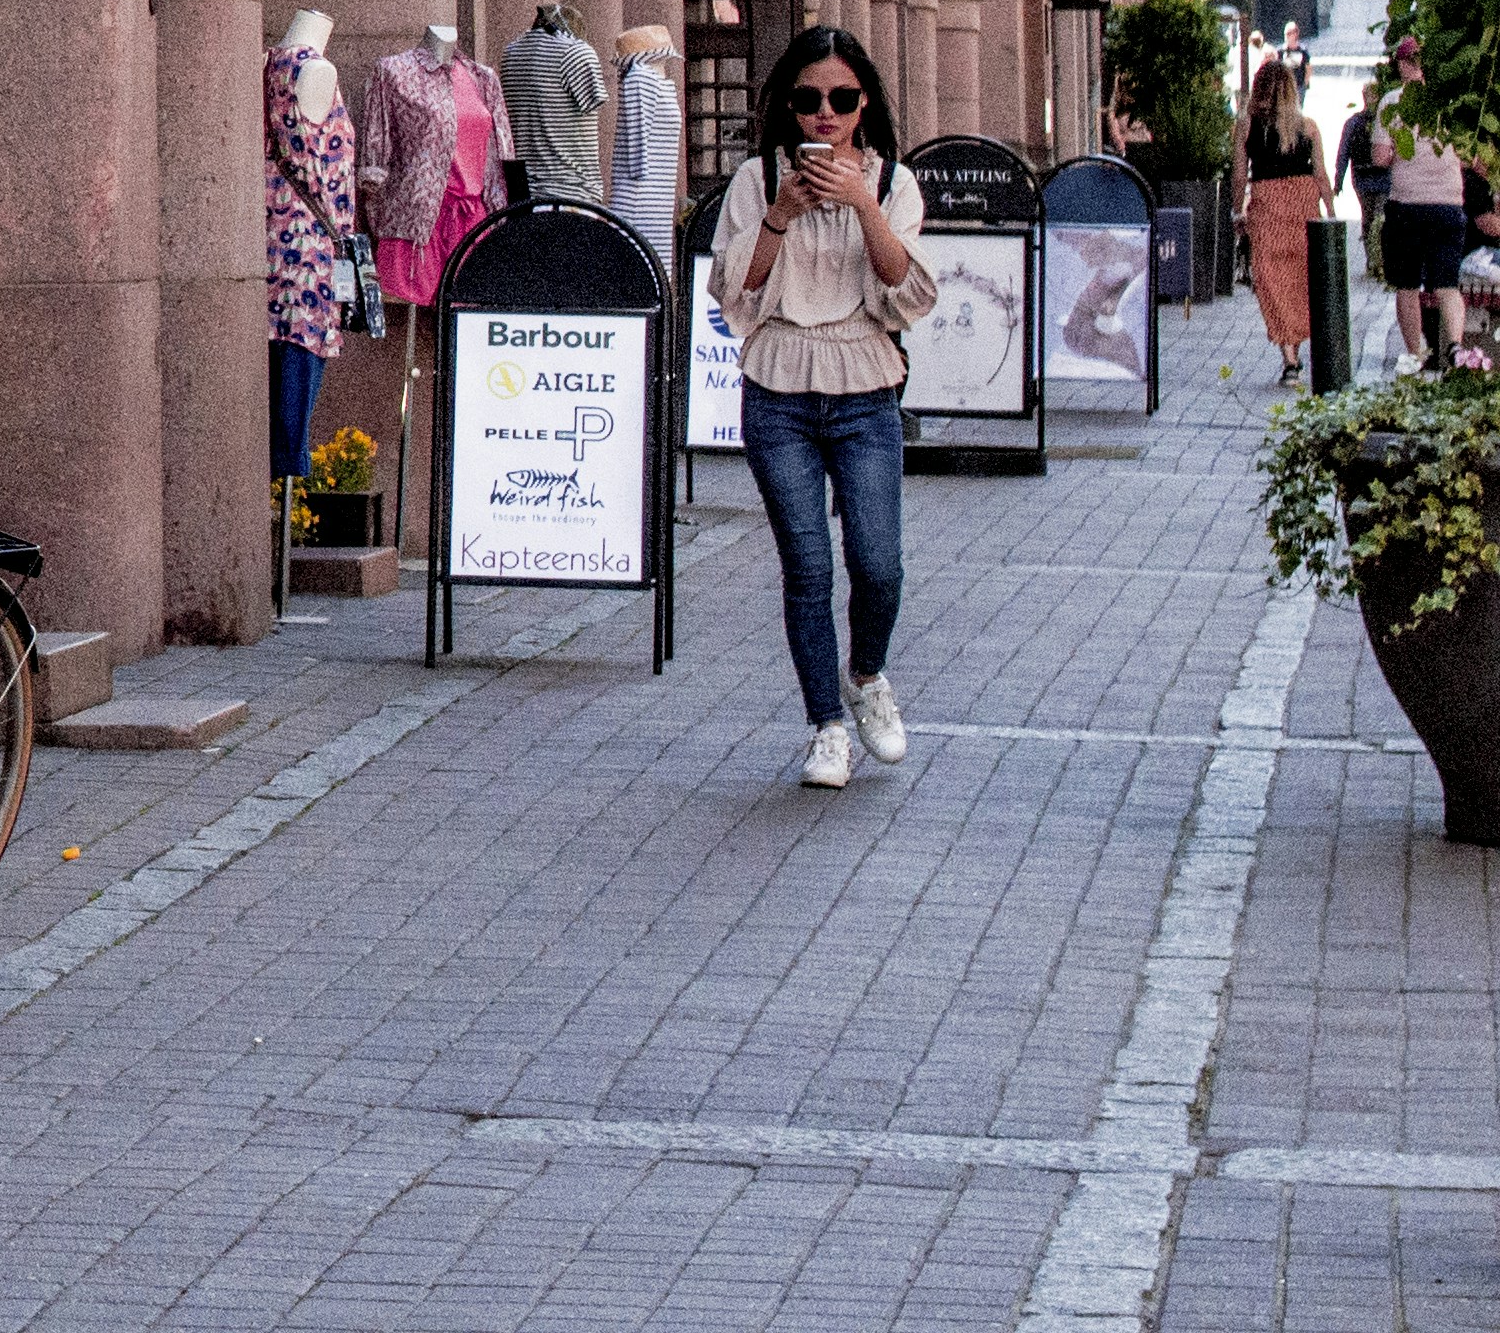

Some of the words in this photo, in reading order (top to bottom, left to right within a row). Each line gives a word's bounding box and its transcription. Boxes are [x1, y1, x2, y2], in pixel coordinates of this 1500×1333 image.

[953, 169, 1012, 183] ATTLING
[487, 321, 616, 350] Barbour
[695, 344, 741, 364] SAIN
[532, 372, 616, 393] AIGLE
[484, 427, 548, 441] PELLE
[489, 479, 551, 506] Weird
[557, 483, 605, 512] fish
[461, 533, 631, 575] Kapteenska
